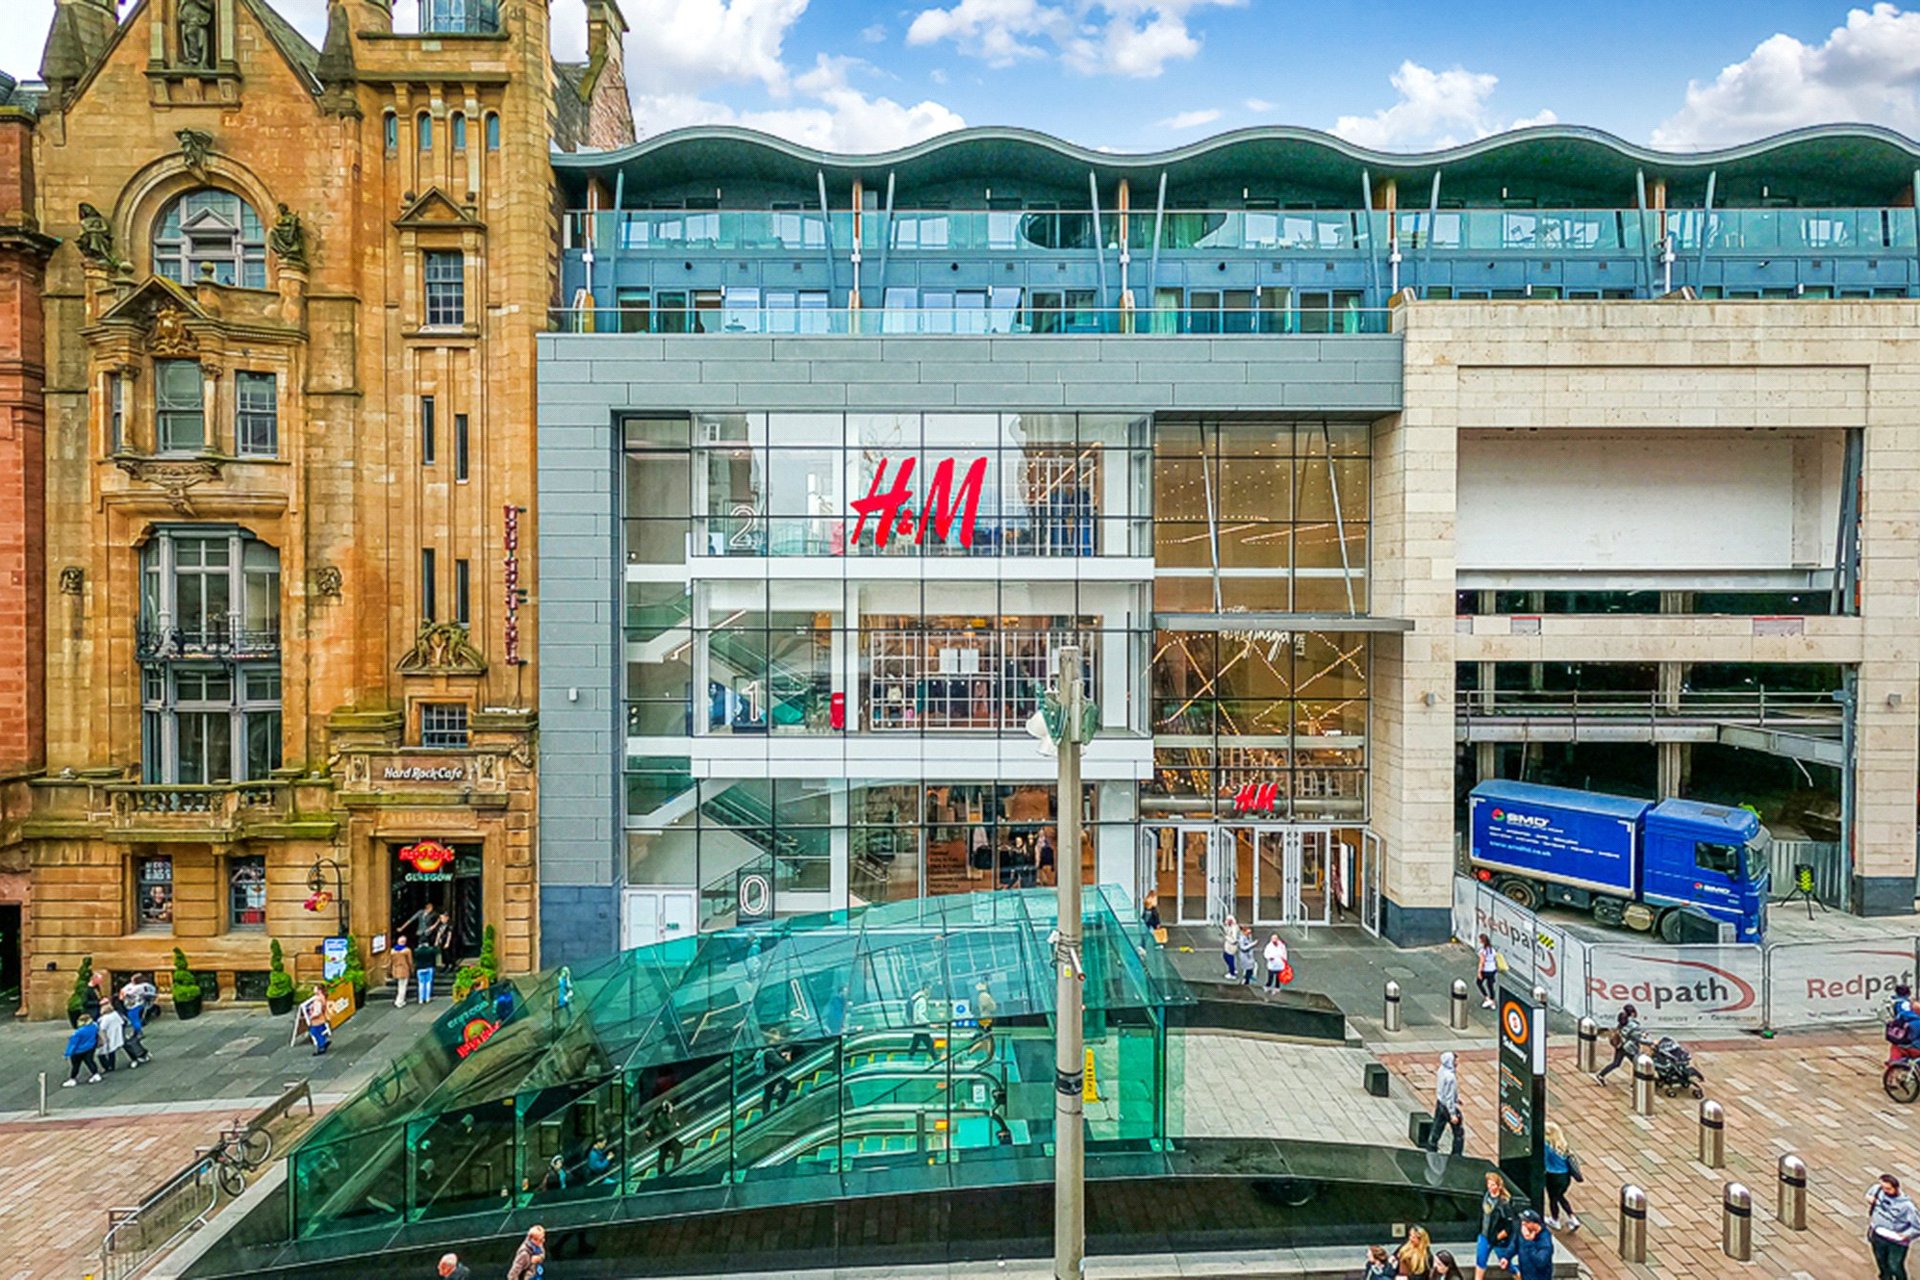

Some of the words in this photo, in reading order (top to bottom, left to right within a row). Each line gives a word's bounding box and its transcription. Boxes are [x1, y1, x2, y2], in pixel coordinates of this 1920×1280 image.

[850, 456, 988, 549] H&M
[384, 767, 411, 778] Hard
[412, 767, 437, 780] Rock
[405, 872, 453, 882] GLASGOW
[1586, 977, 1728, 1009] Redpath
[1807, 969, 1913, 1000] Redpat
